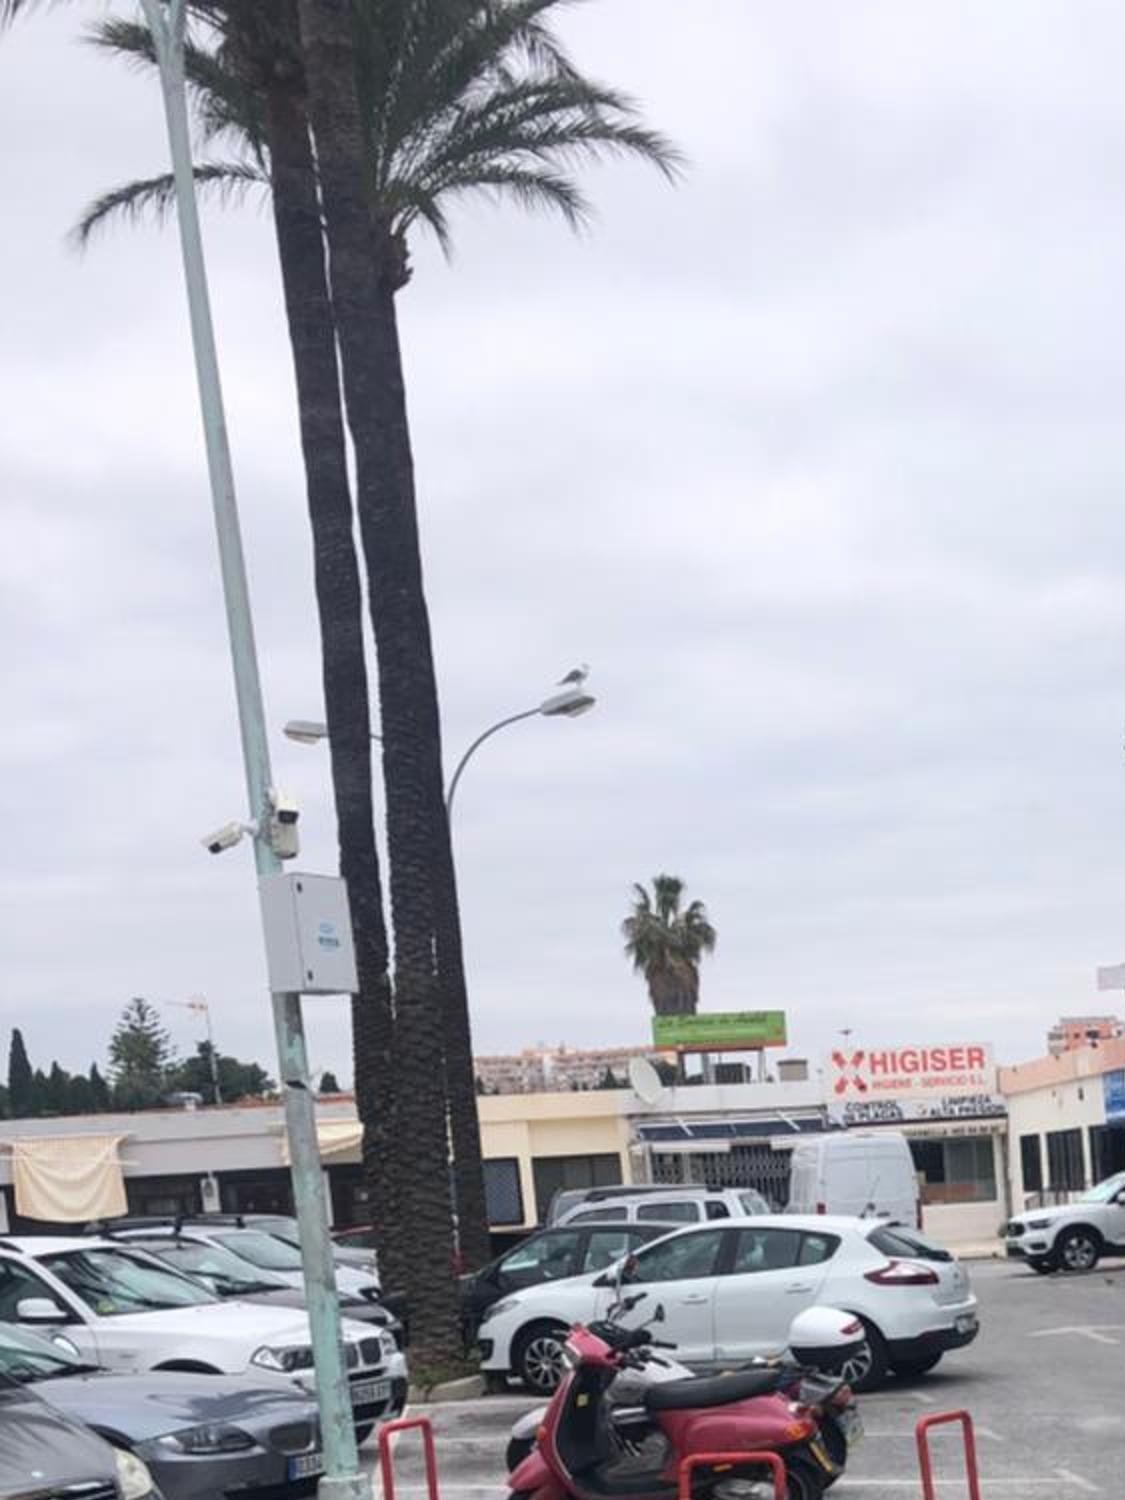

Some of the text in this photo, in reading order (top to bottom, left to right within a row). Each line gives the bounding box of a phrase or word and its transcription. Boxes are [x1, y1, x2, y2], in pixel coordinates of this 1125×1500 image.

[870, 1047, 985, 1075] HIGISER
[845, 1099, 898, 1112] CONTROL
[930, 1104, 955, 1117] ALTA
